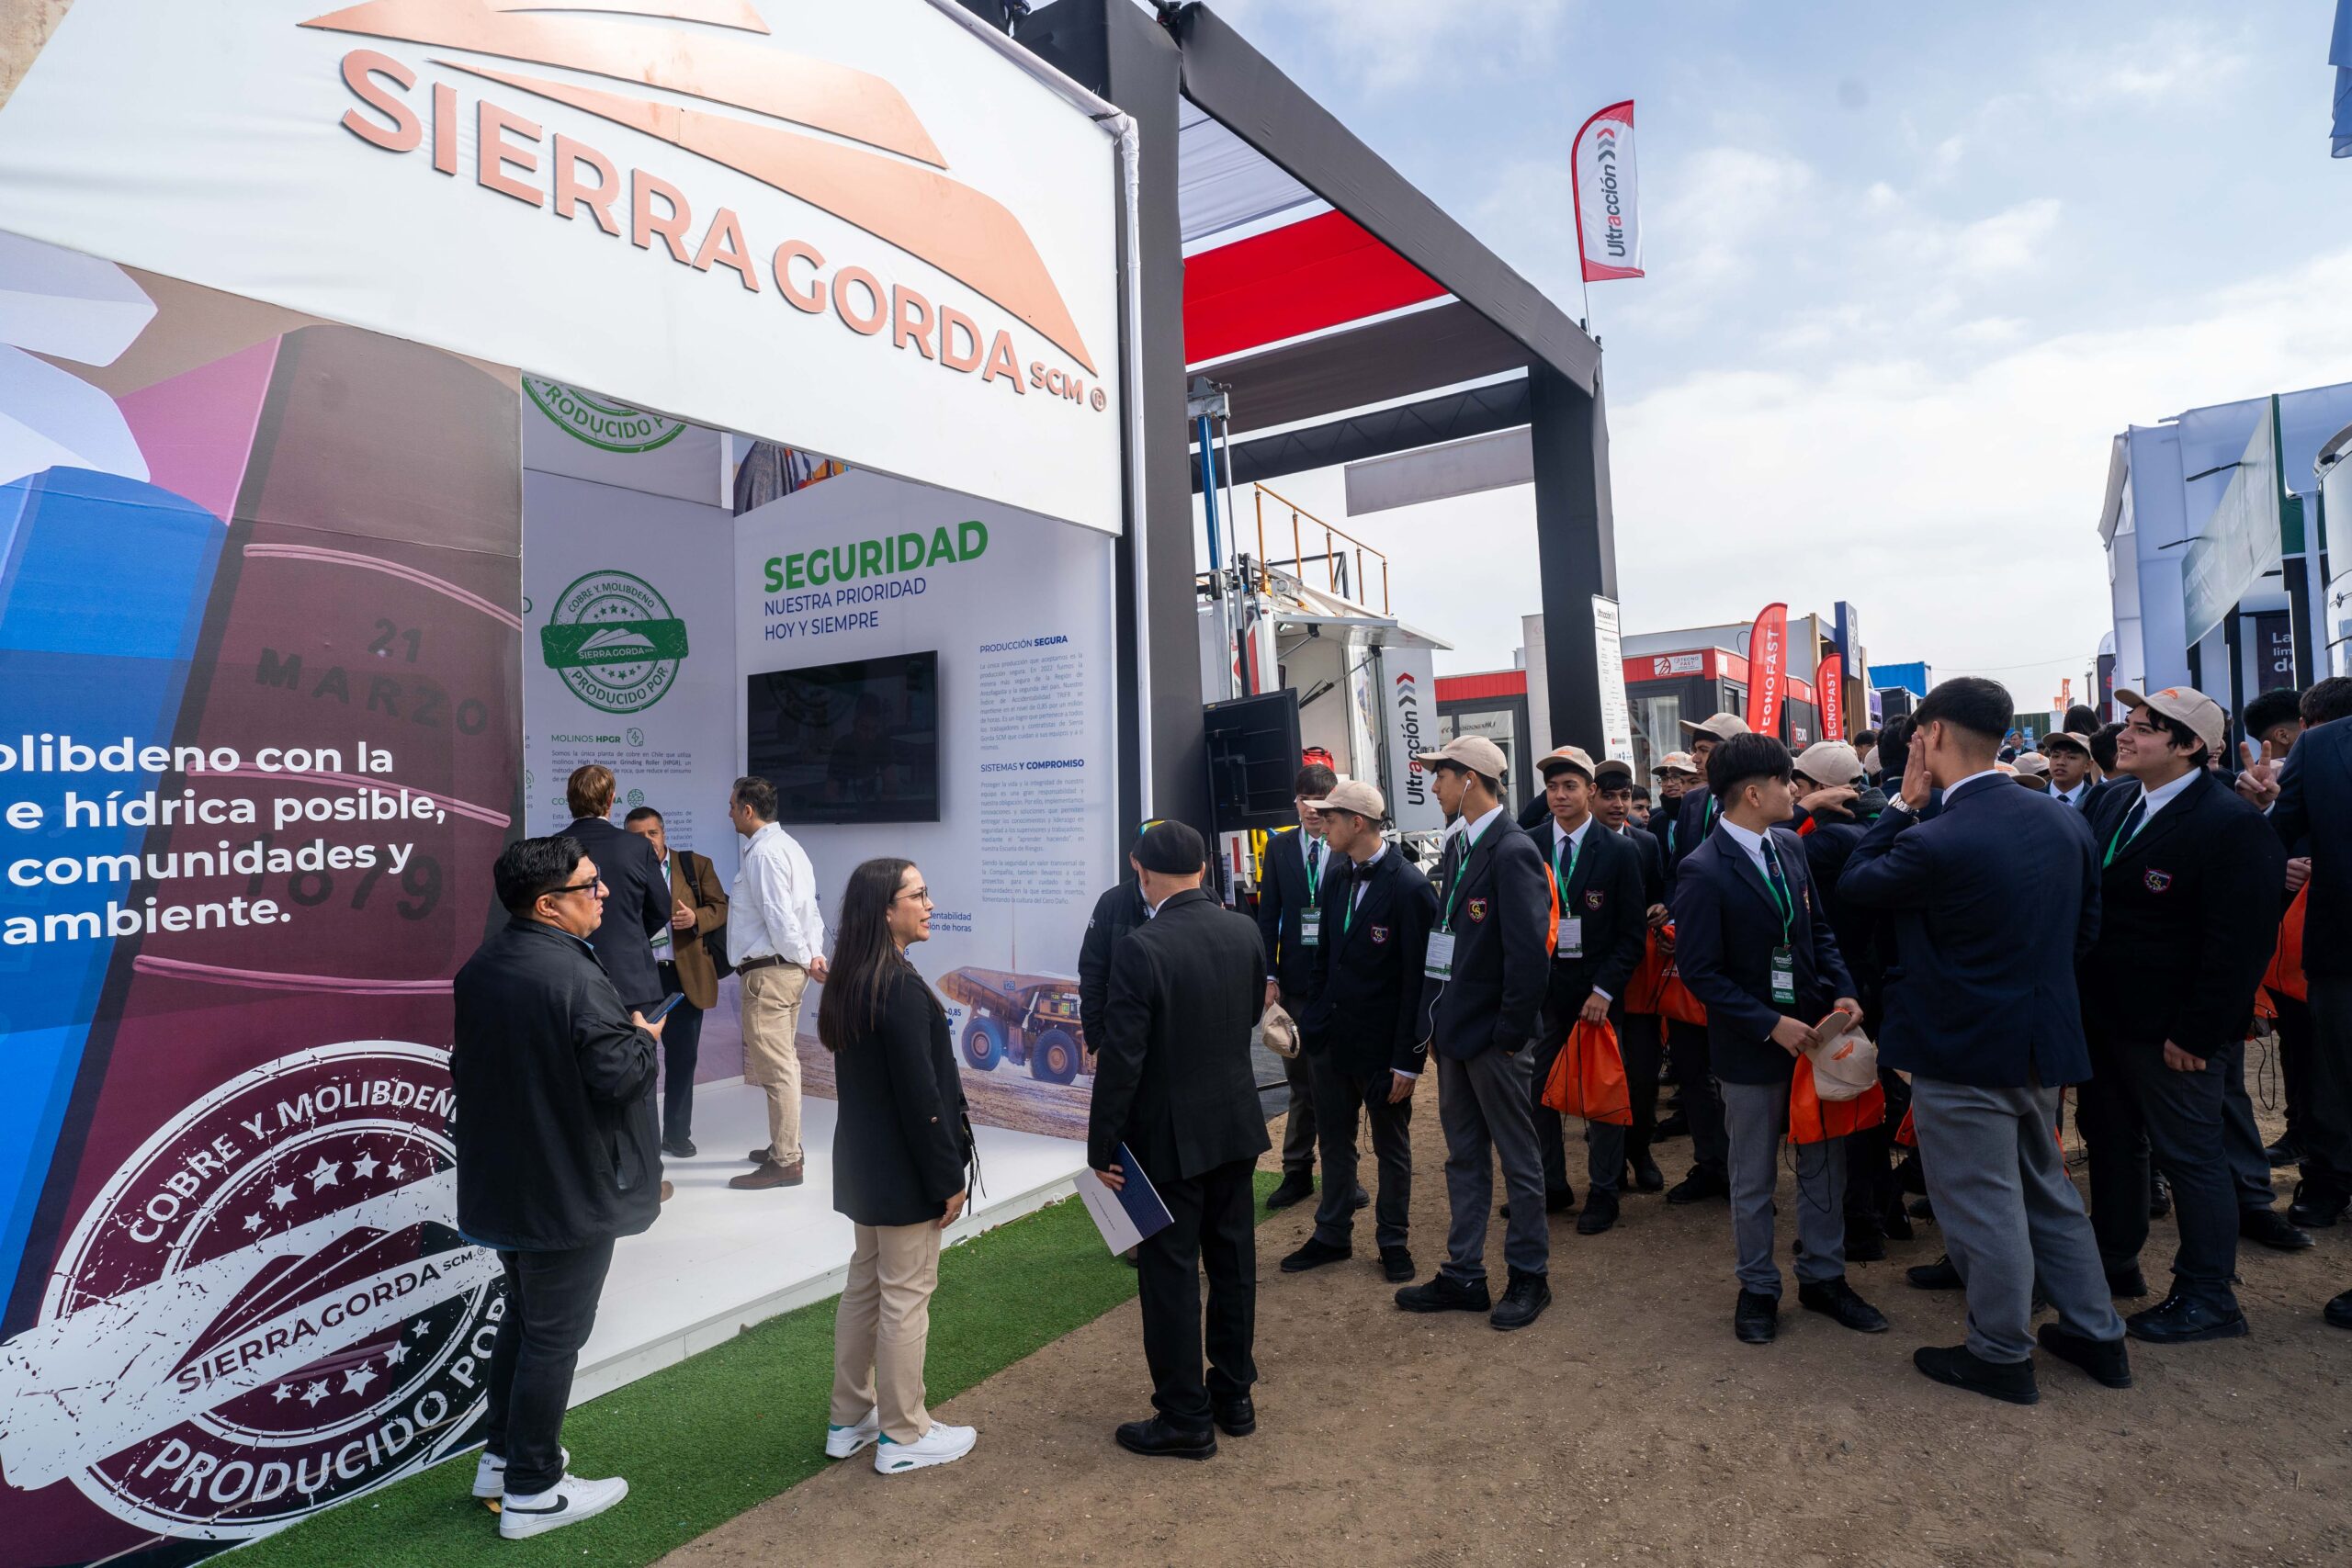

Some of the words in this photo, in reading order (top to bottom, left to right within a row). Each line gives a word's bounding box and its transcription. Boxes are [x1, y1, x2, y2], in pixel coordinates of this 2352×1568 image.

[1600, 164, 1625, 257] Ultracción
[542, 381, 650, 438] RODUCIDO
[764, 520, 989, 593] SEGURIDAD
[568, 588, 594, 613] COBRE
[602, 582, 655, 608] MOLIBDENO
[764, 592, 831, 616] NUESTRA
[836, 577, 926, 606] PRIORIDAD
[369, 619, 422, 662] 21
[765, 622, 796, 641] HOY
[797, 620, 808, 637] Y
[811, 610, 878, 636] SIEMPRE
[979, 639, 1033, 653] PRODUCCIÓN
[1035, 635, 1068, 647] SEGURA
[254, 648, 490, 735] MARZO
[571, 671, 647, 705] PRODUCIDO
[646, 666, 668, 693] POR
[1826, 671, 1838, 741] ECNOFAST
[255, 748, 342, 773] con
[357, 741, 394, 773] la
[981, 762, 1018, 773] SISTEMAS
[1026, 759, 1084, 770] COMPROMISO
[1401, 710, 1425, 805] Ultracción
[6, 801, 44, 829] e
[65, 790, 257, 828] hídrica
[275, 788, 447, 830] posible,
[7, 836, 377, 887] comunidades
[387, 842, 414, 874] y
[3, 897, 292, 946] ambiente.
[942, 923, 950, 931] de
[952, 923, 972, 932] horas
[130, 1131, 241, 1245] COBRE
[240, 1111, 271, 1141] Y
[277, 1079, 458, 1132] MOLIBDEN
[443, 1251, 473, 1271] SCM
[141, 1390, 448, 1504] PRODUCIDO
